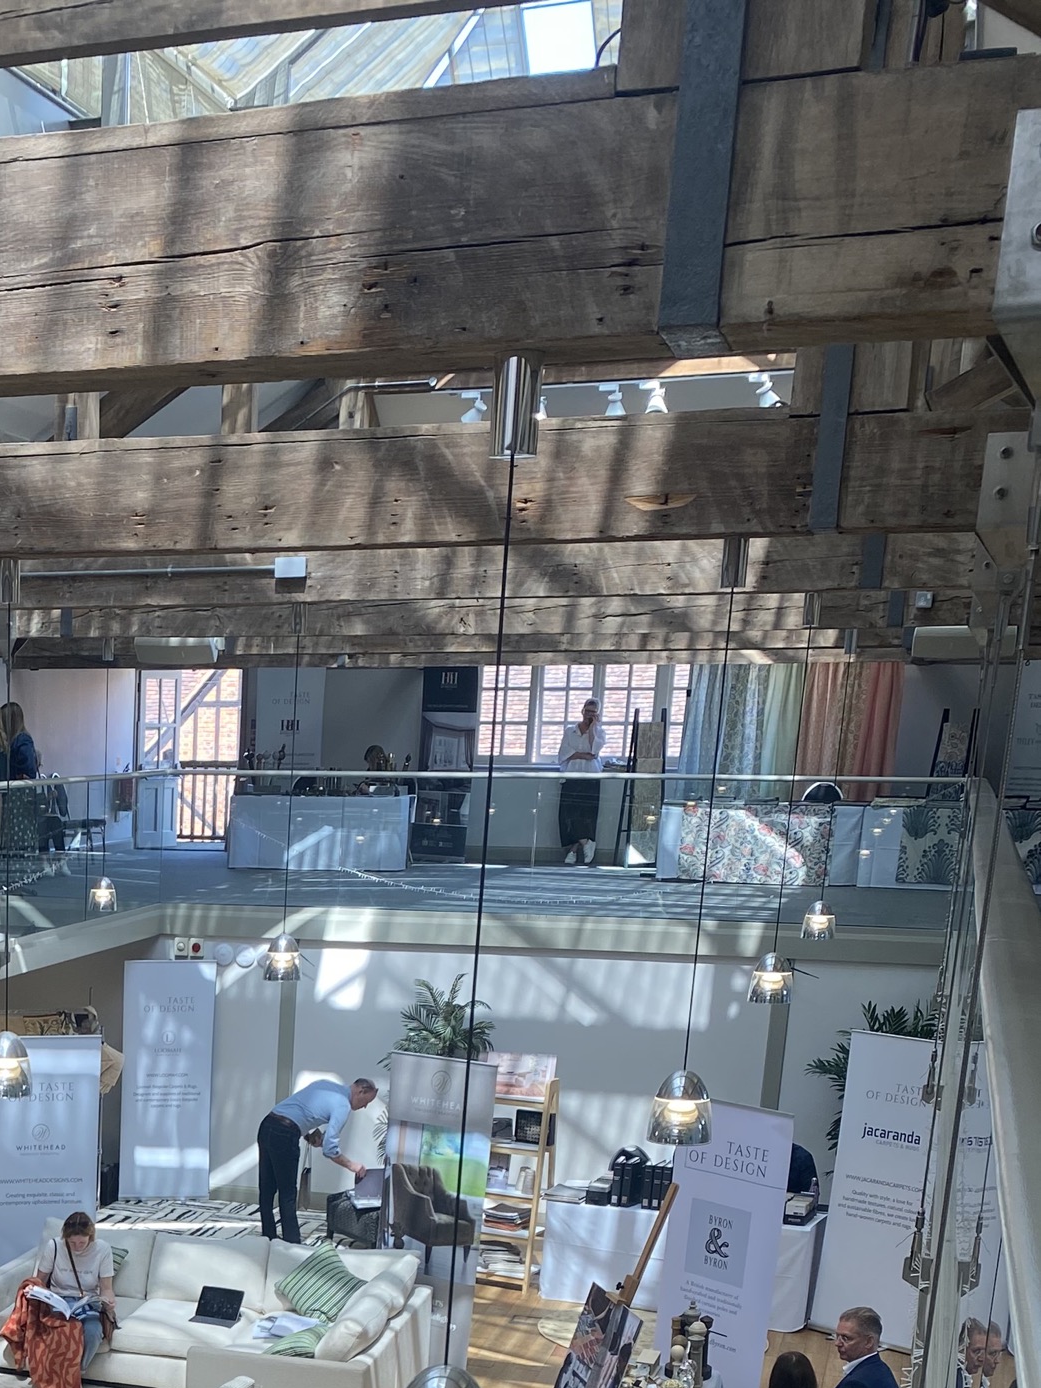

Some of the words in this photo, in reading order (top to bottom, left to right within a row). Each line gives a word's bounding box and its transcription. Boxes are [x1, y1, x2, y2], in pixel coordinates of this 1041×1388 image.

[167, 996, 195, 1005] TASTE
[159, 1005, 195, 1013] DESIGN
[39, 1081, 74, 1091] TASTE
[895, 1083, 923, 1096] TAST
[29, 1092, 74, 1102] DESIGN
[865, 1089, 881, 1100] OF
[411, 1096, 461, 1111] WHITEHEA
[861, 1122, 921, 1145] jacaranda
[726, 1140, 770, 1163] TASTE
[689, 1149, 708, 1164] OF
[713, 1154, 767, 1178] DESIGN
[708, 1214, 733, 1230] BYRON
[705, 1227, 730, 1258] &
[704, 1254, 728, 1270] BYRON
